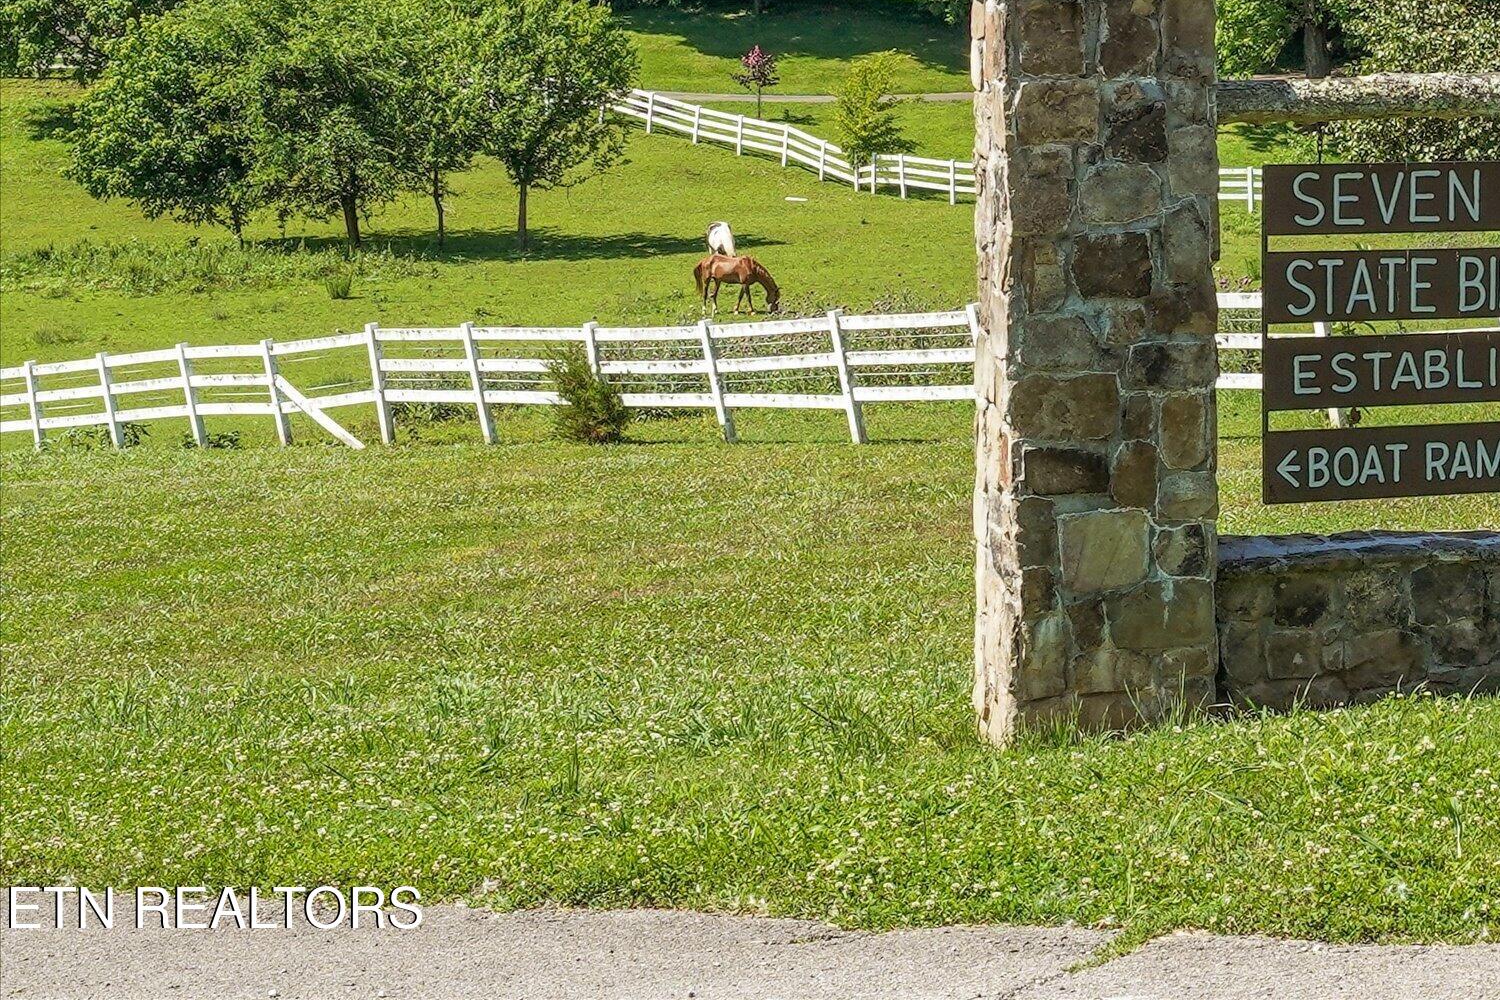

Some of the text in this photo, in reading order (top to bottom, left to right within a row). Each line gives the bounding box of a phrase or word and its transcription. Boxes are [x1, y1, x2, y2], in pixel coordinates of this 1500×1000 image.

[1292, 168, 1481, 226] SEVEN
[1285, 256, 1438, 316] STATE
[1307, 443, 1409, 488] BOAT
